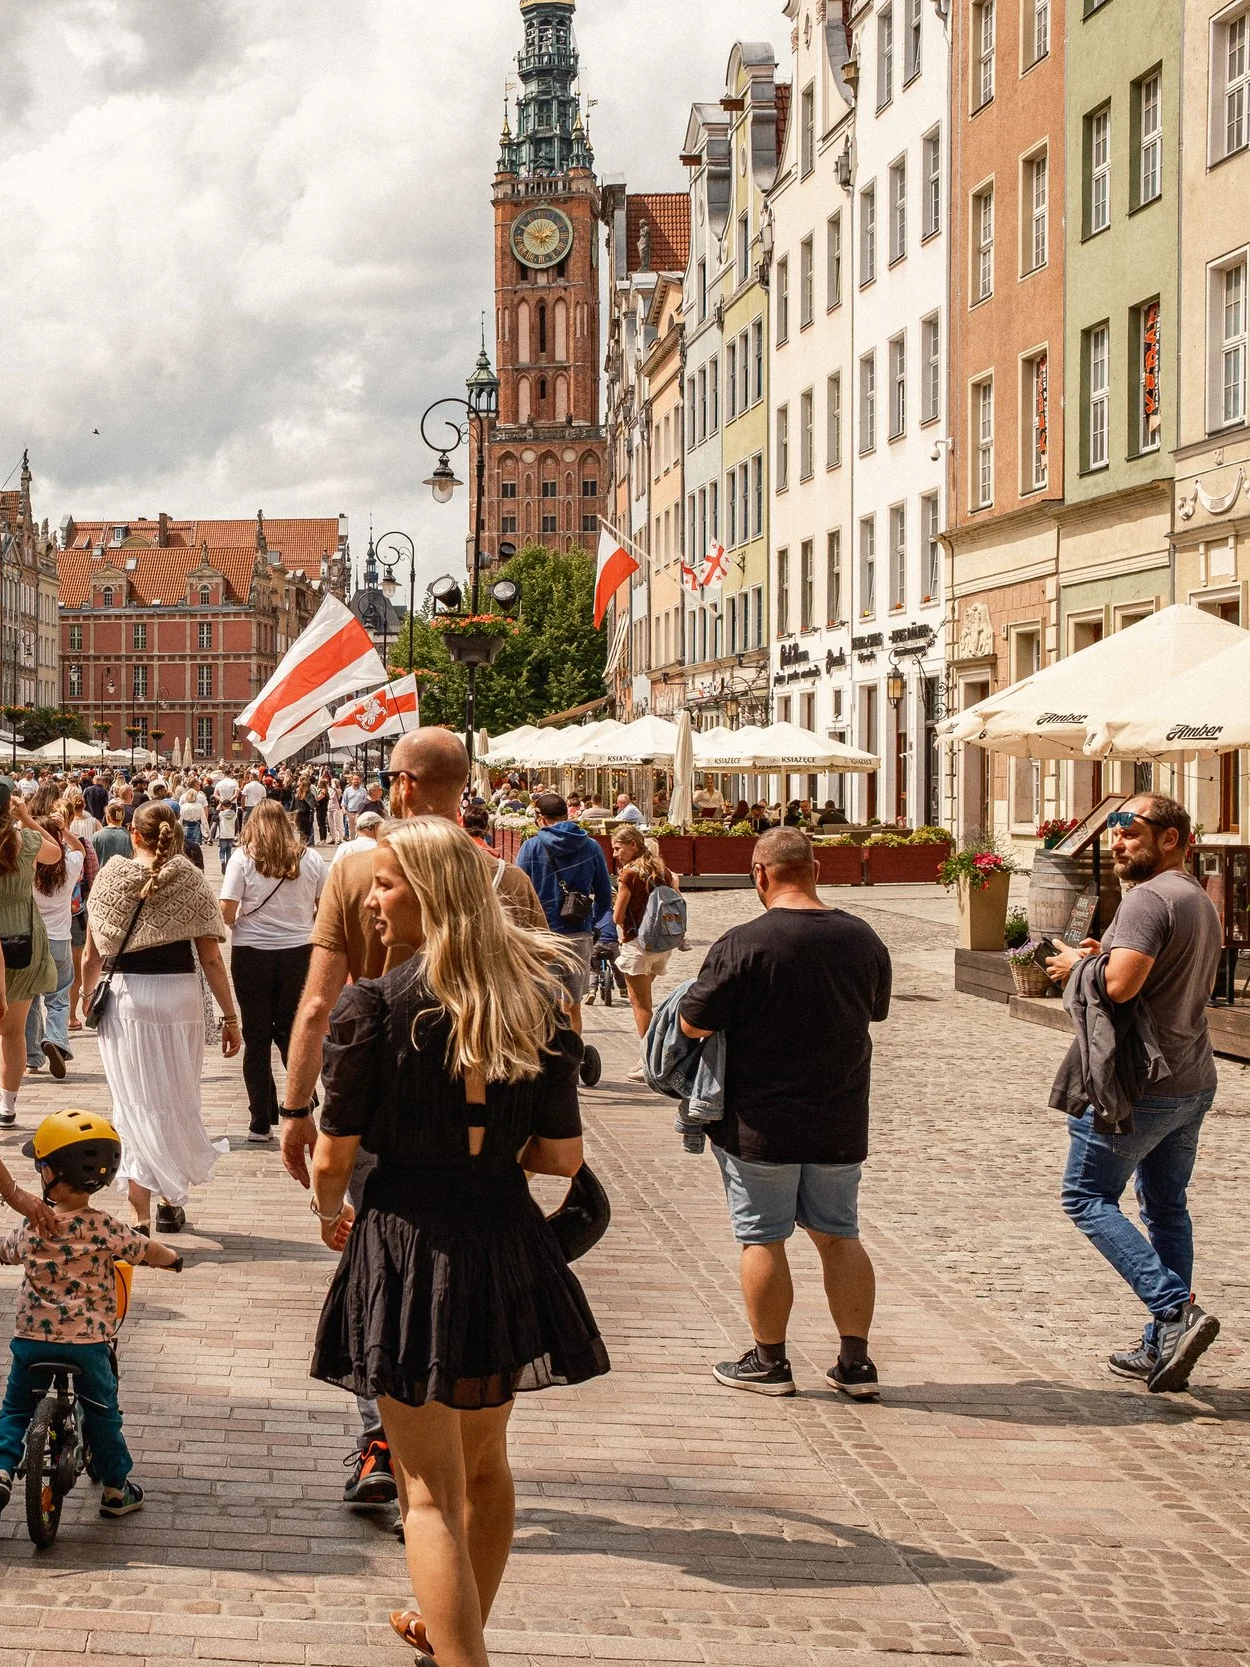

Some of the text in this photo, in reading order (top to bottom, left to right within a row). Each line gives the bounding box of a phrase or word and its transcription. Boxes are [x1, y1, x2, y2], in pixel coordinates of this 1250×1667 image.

[1036, 712, 1089, 726] Amber
[1166, 724, 1224, 741] Amber
[781, 756, 817, 765] KSIĄŻĘCE
